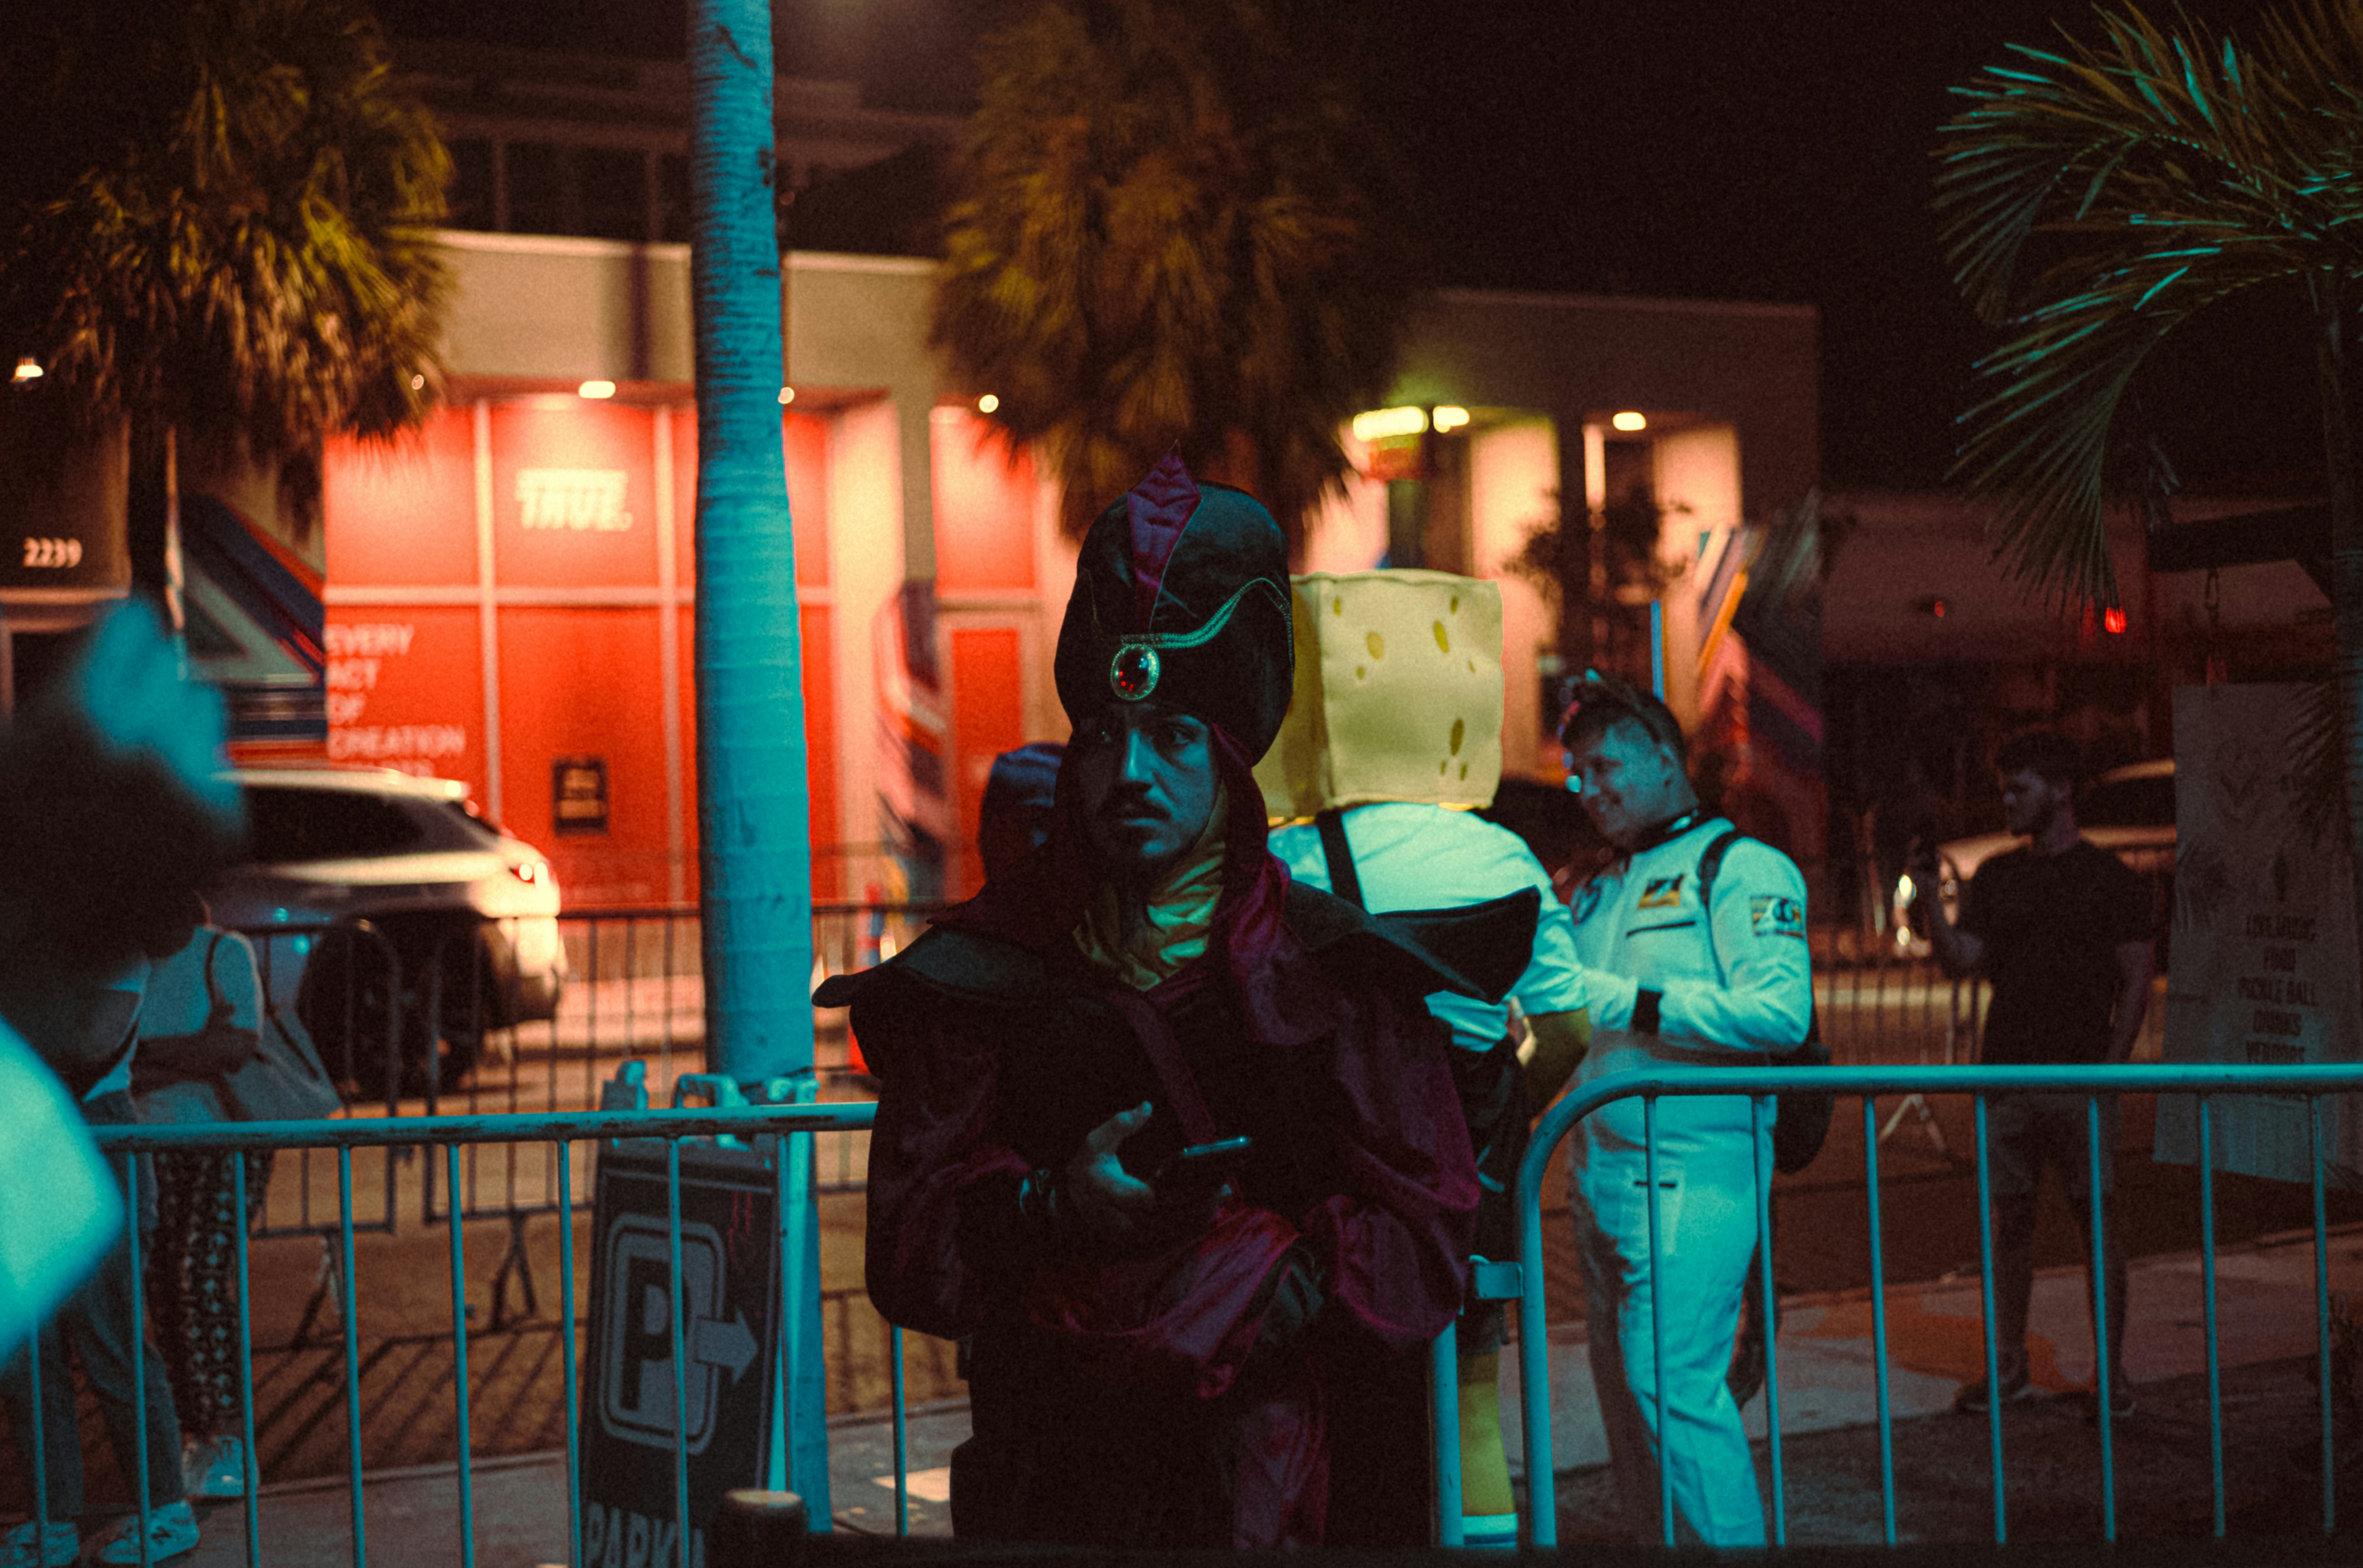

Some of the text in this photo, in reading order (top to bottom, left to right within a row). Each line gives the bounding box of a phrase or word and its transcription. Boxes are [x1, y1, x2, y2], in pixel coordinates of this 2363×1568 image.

[22, 537, 82, 568] 2239
[326, 623, 414, 656] EVERY
[328, 658, 381, 690] ACT
[328, 693, 367, 725] OF
[328, 724, 466, 759] CREATION
[2286, 980, 2318, 1007] BALL
[619, 1255, 692, 1412] P
